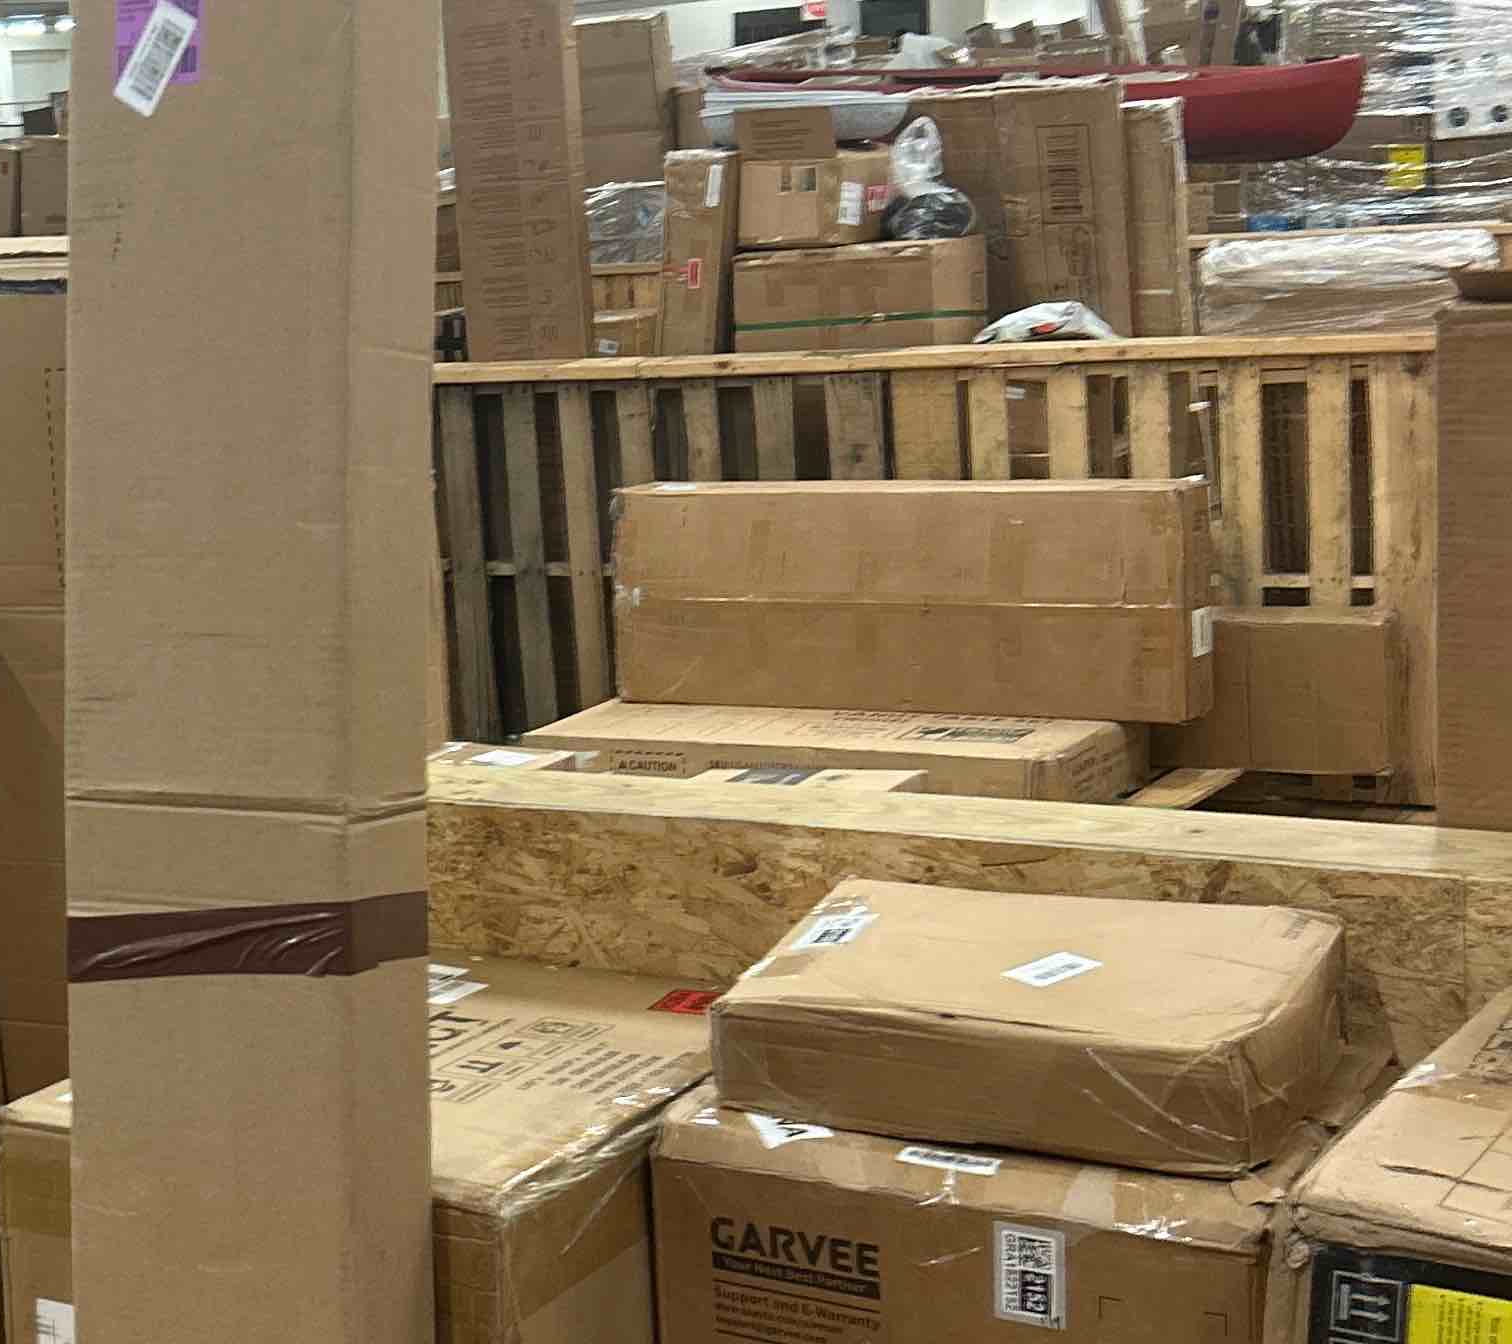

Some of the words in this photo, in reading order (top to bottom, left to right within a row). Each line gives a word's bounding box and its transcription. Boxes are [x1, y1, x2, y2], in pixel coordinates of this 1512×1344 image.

[628, 760, 677, 773] CAUTION
[710, 1216, 880, 1278] GARVEE
[714, 1287, 769, 1309] Support
[774, 1298, 799, 1314] and
